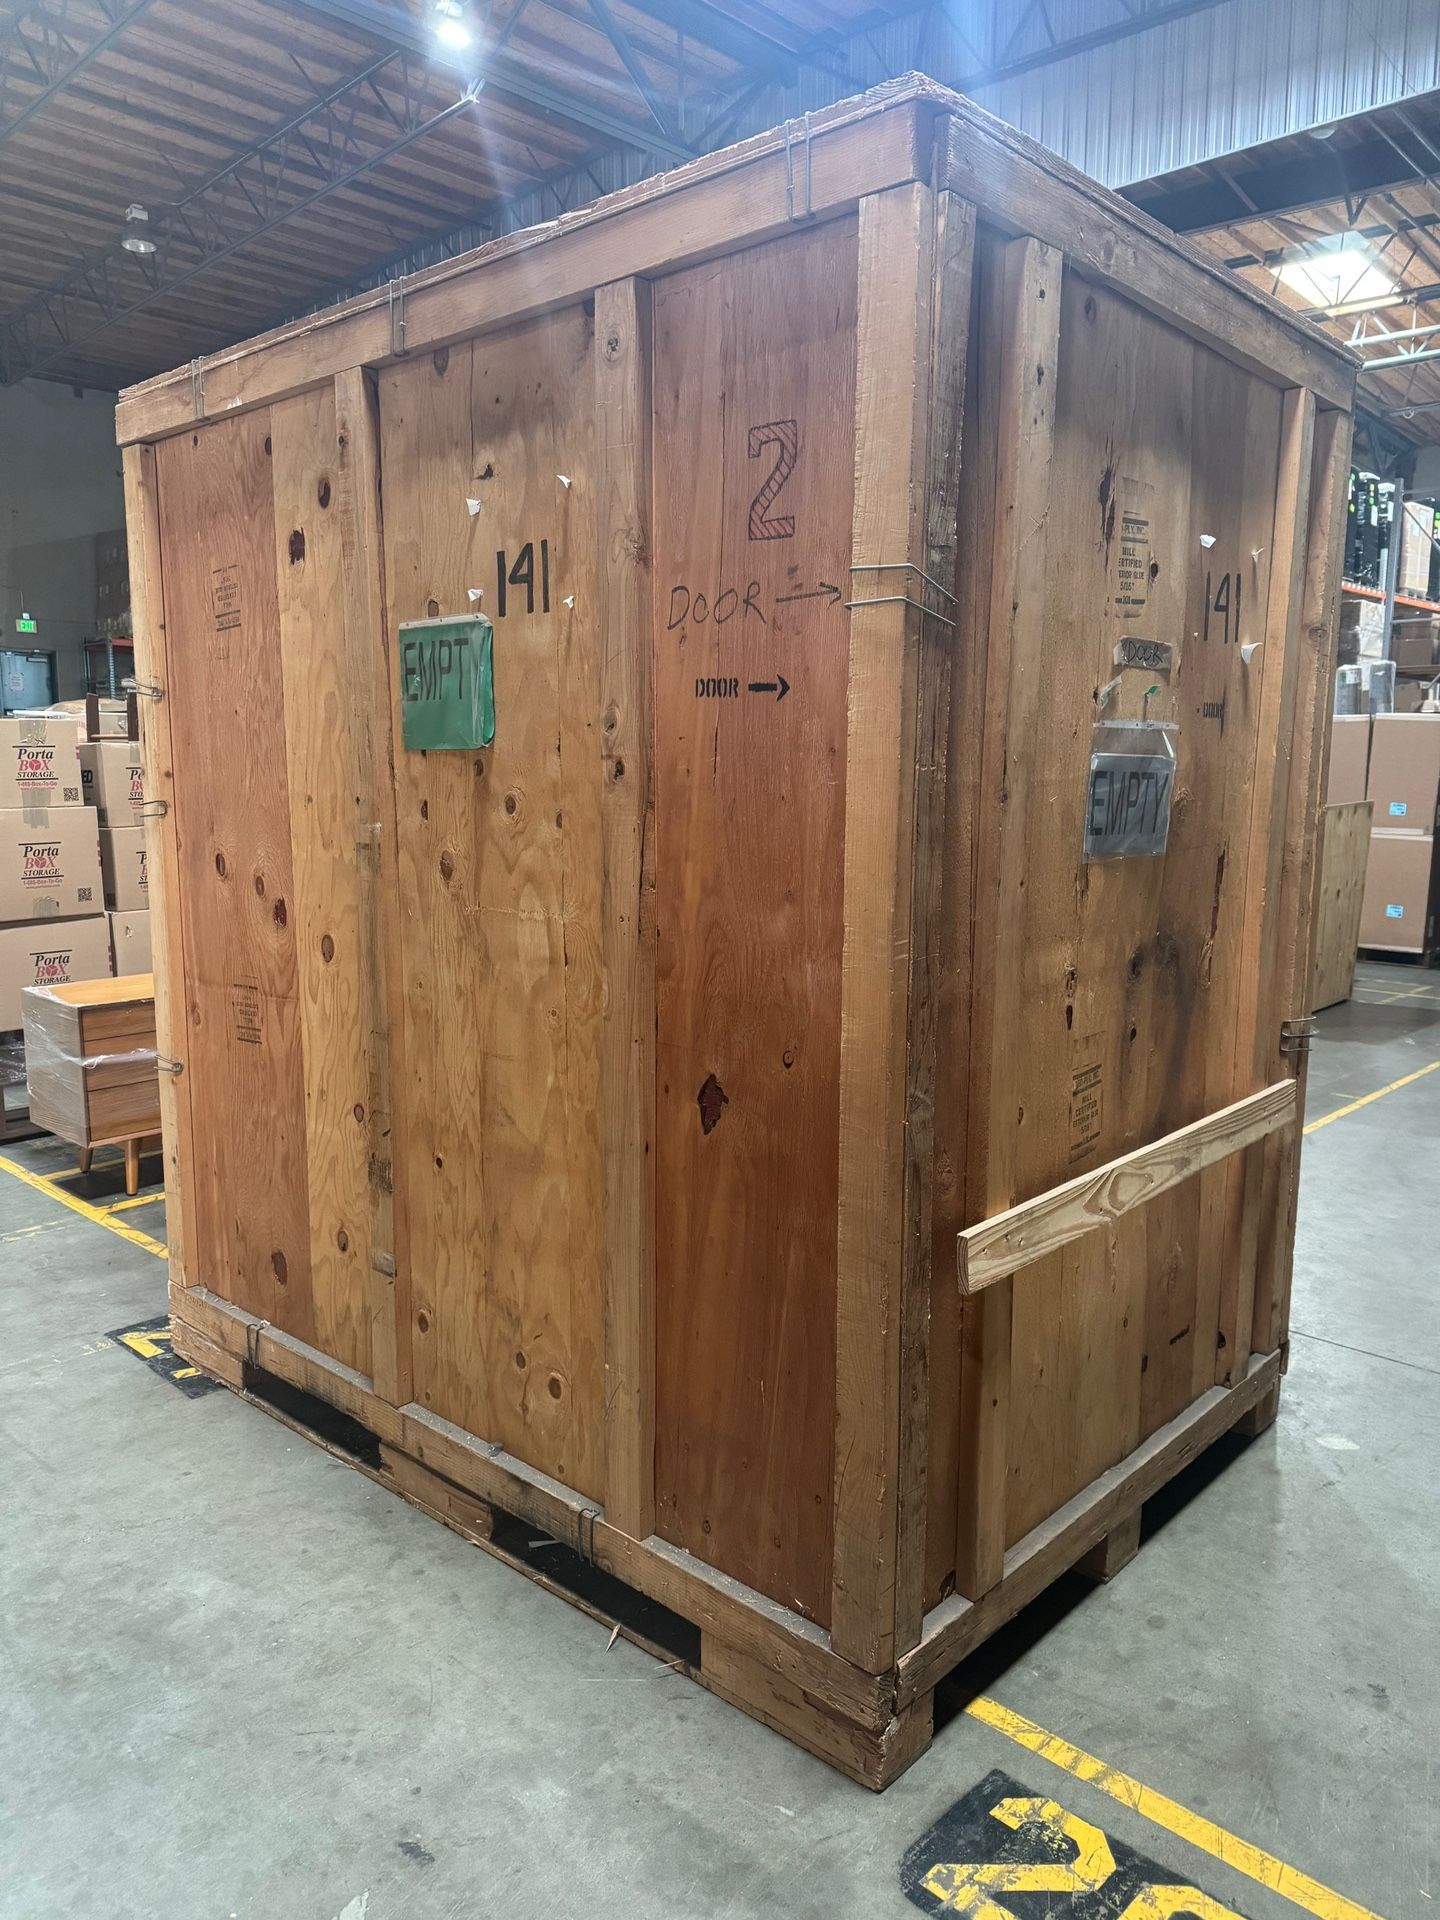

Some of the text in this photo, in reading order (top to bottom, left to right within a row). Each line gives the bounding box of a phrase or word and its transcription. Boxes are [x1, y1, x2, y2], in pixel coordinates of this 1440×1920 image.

[748, 419, 797, 541] 2
[497, 538, 550, 618] 141
[667, 581, 767, 630] DOOR
[1203, 571, 1242, 644] 141
[695, 677, 740, 699] DOOR
[17, 748, 54, 760] Porta
[19, 759, 51, 771] BOX
[1089, 770, 1170, 837] EMPTY
[23, 845, 59, 858] Porta
[25, 856, 56, 870] BOX
[23, 868, 61, 877] STORAGE
[34, 953, 70, 967] Porta
[36, 963, 67, 978] BOX
[34, 974, 71, 986] STORAGE
